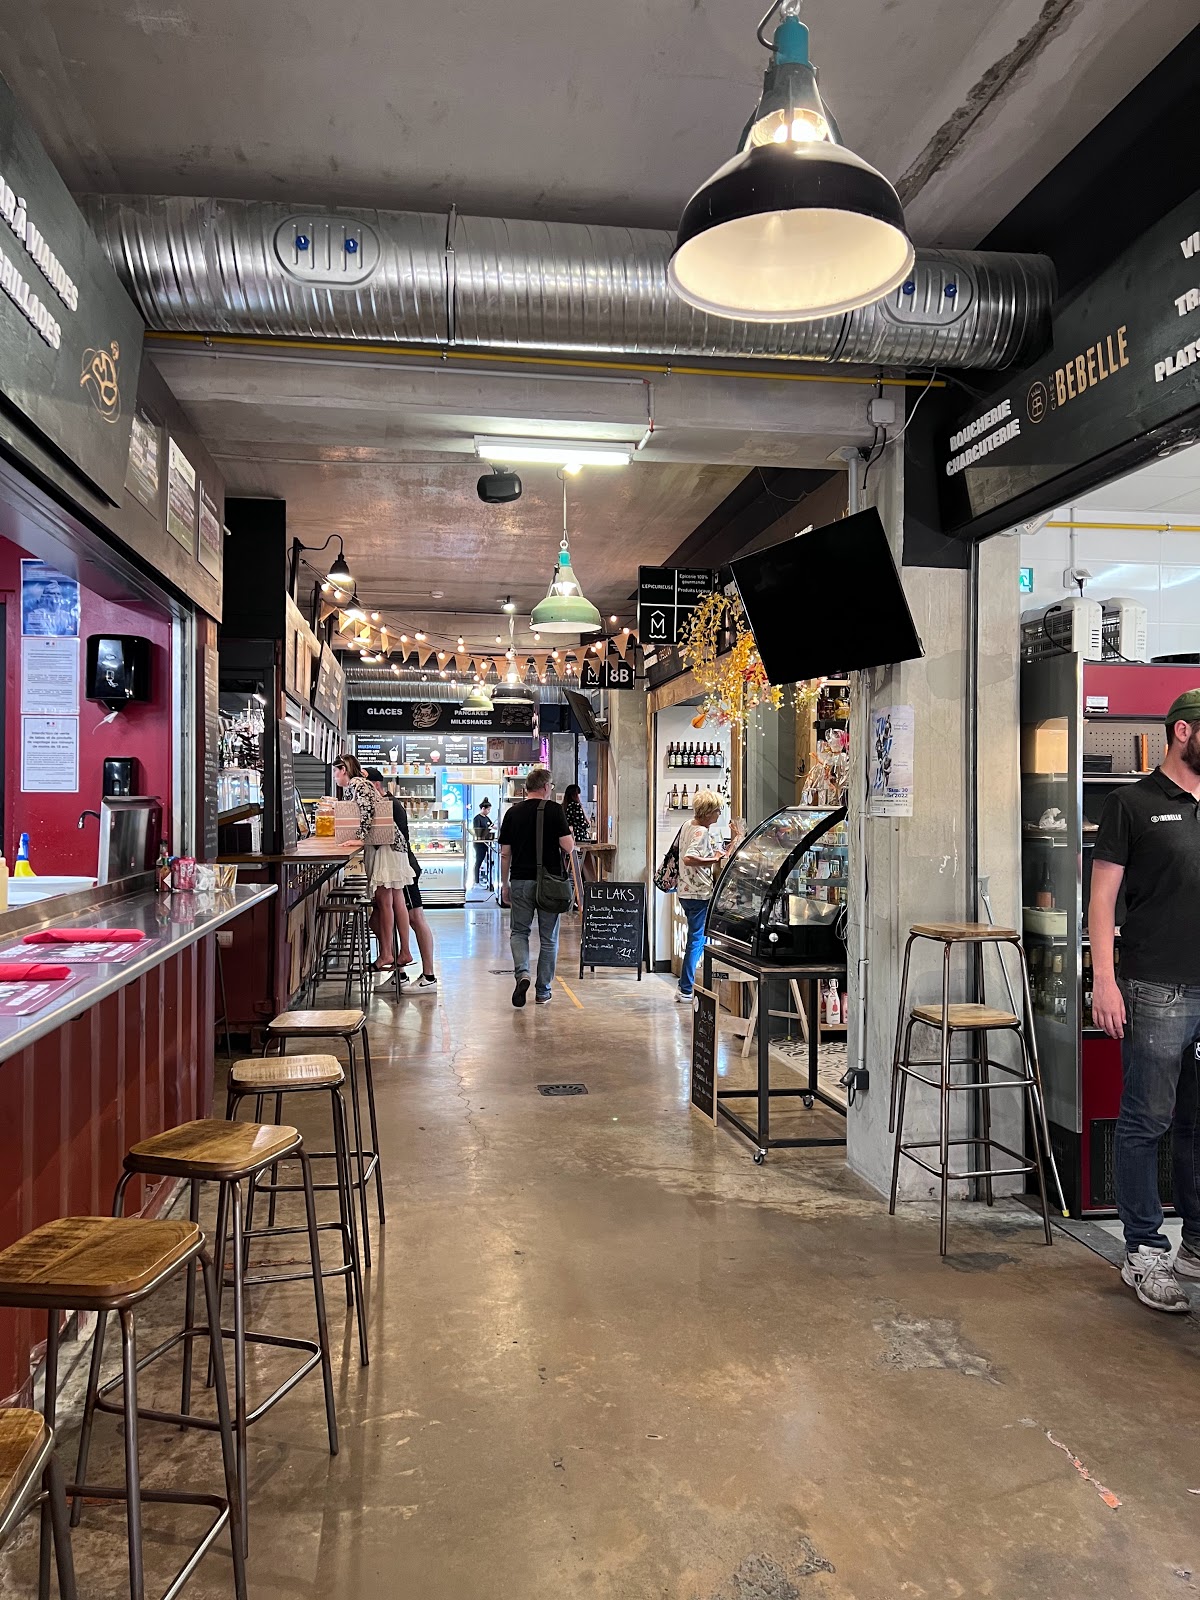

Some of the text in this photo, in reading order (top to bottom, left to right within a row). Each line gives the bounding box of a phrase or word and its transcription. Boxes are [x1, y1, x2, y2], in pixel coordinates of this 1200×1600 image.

[26, 221, 79, 312] VIANDES
[1174, 288, 1200, 317] TR
[1055, 325, 1130, 407] BEBELLE
[949, 398, 1012, 452] BOUCHERIE
[945, 418, 1021, 476] CHARCUTERIE
[610, 668, 629, 683] 8B
[367, 707, 403, 716] GLACES
[606, 887, 635, 901] LAKS
